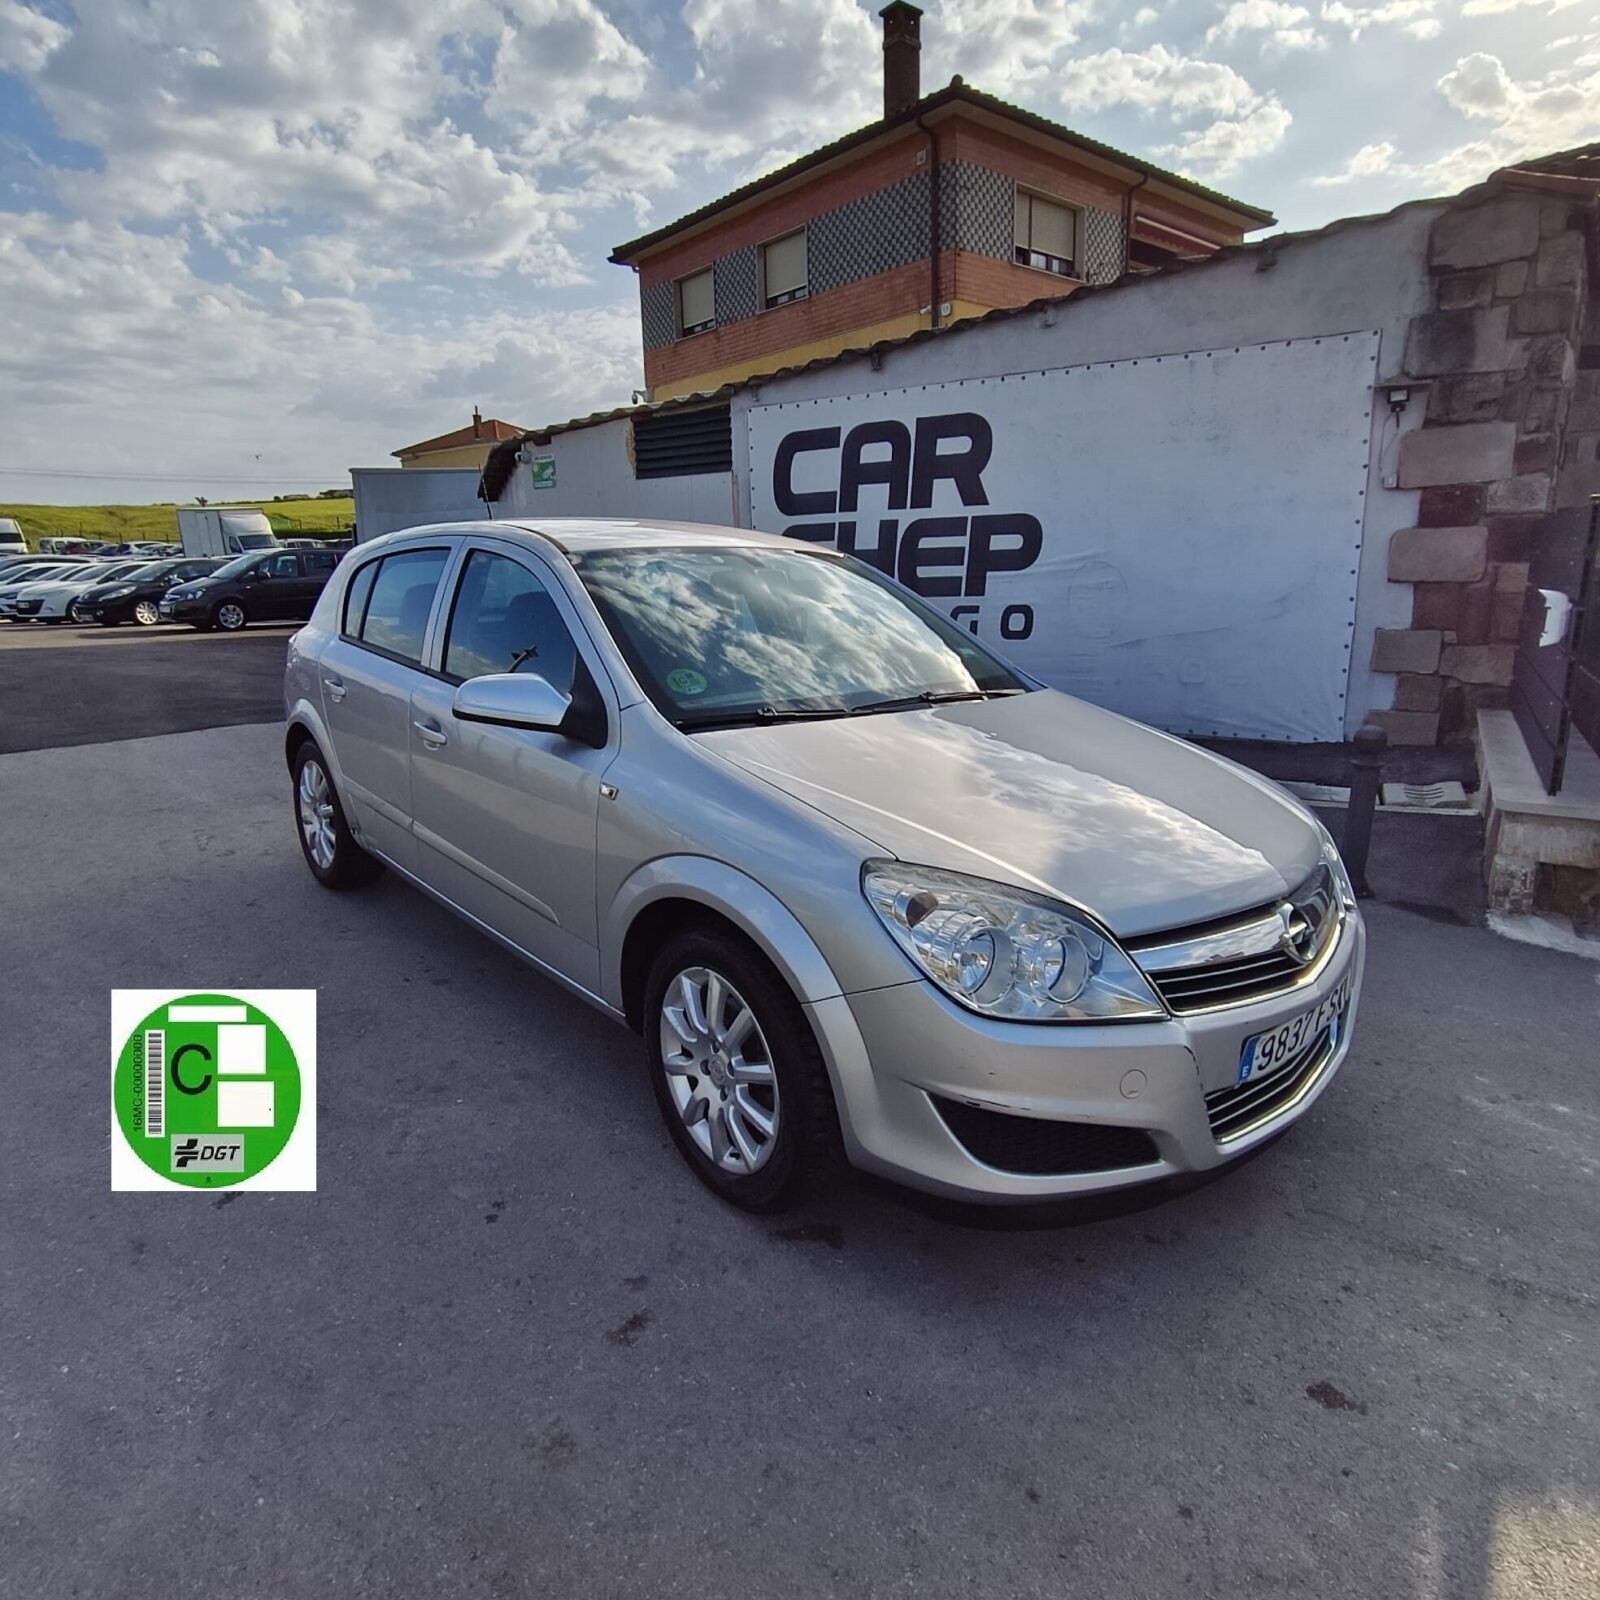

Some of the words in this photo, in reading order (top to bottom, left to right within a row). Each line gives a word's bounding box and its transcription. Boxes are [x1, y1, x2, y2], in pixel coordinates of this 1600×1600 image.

[773, 412, 993, 516] CAR
[1242, 1065, 1249, 1077] E
[1257, 1009, 1314, 1072] 9837
